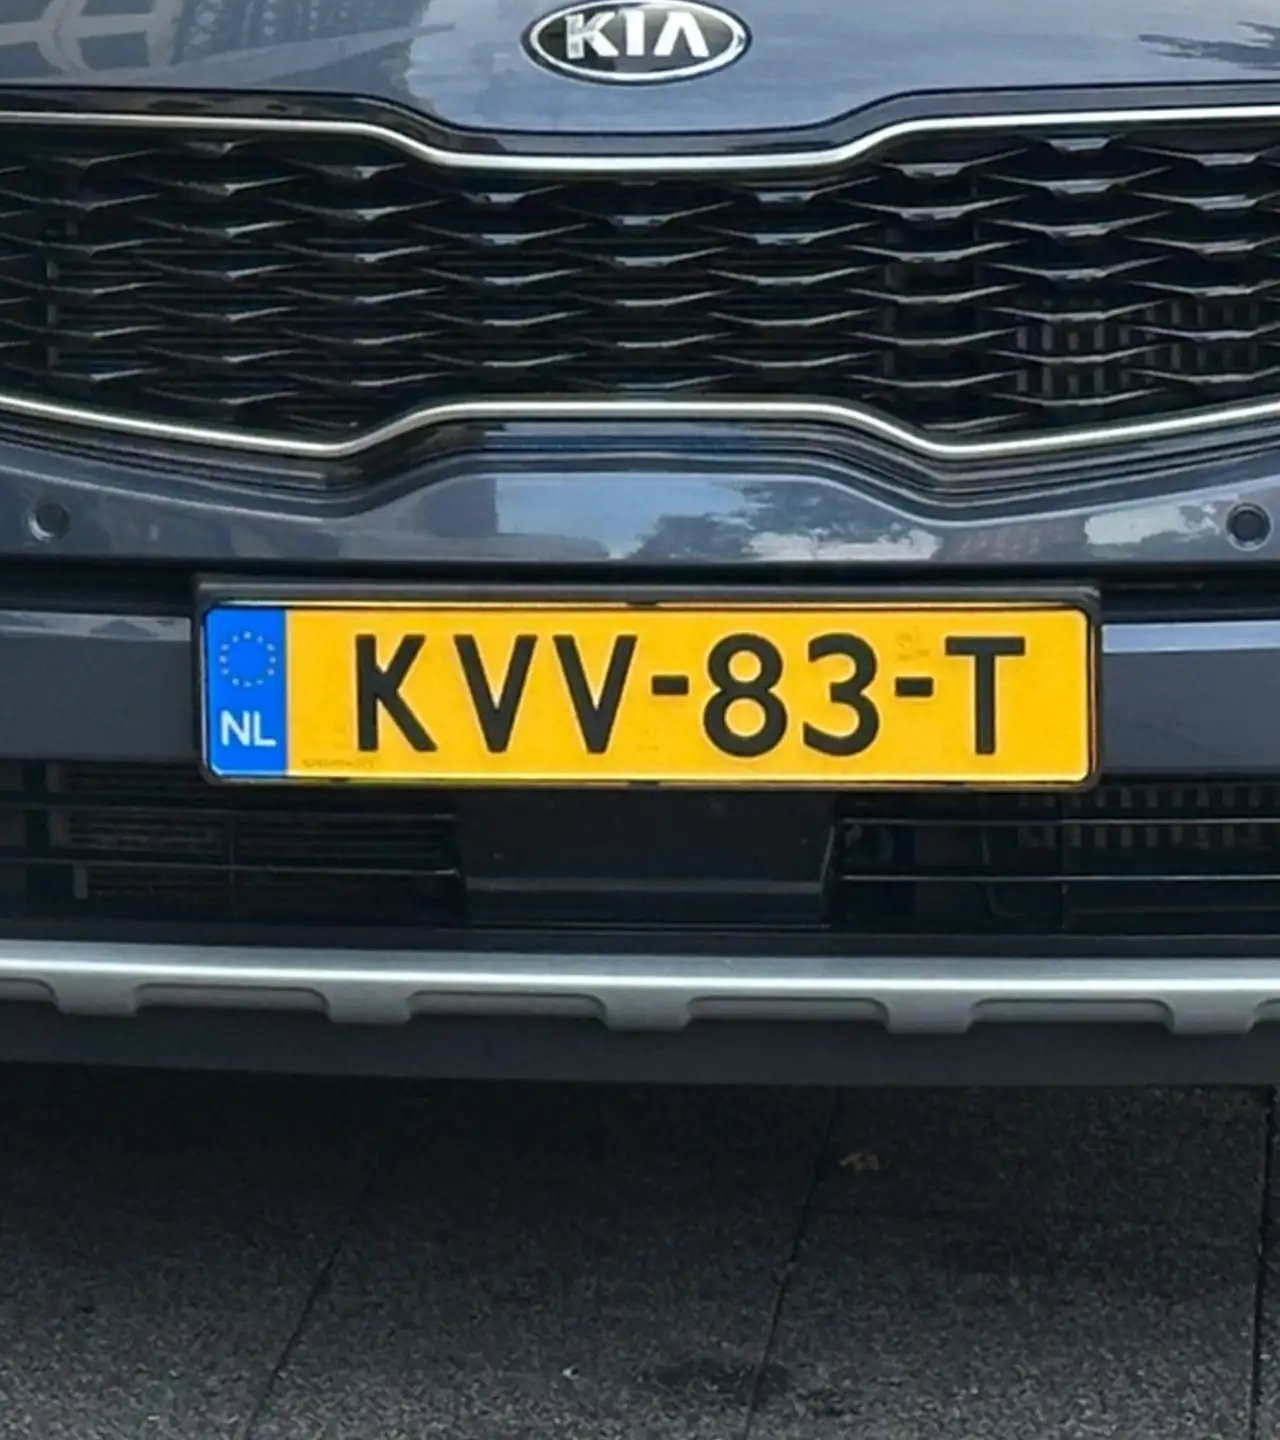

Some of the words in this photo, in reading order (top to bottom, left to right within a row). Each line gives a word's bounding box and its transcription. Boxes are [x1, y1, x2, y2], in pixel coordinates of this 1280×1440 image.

[565, 4, 710, 60] KIA
[353, 632, 1026, 758] KVV-83-T
[220, 708, 277, 748] NL
